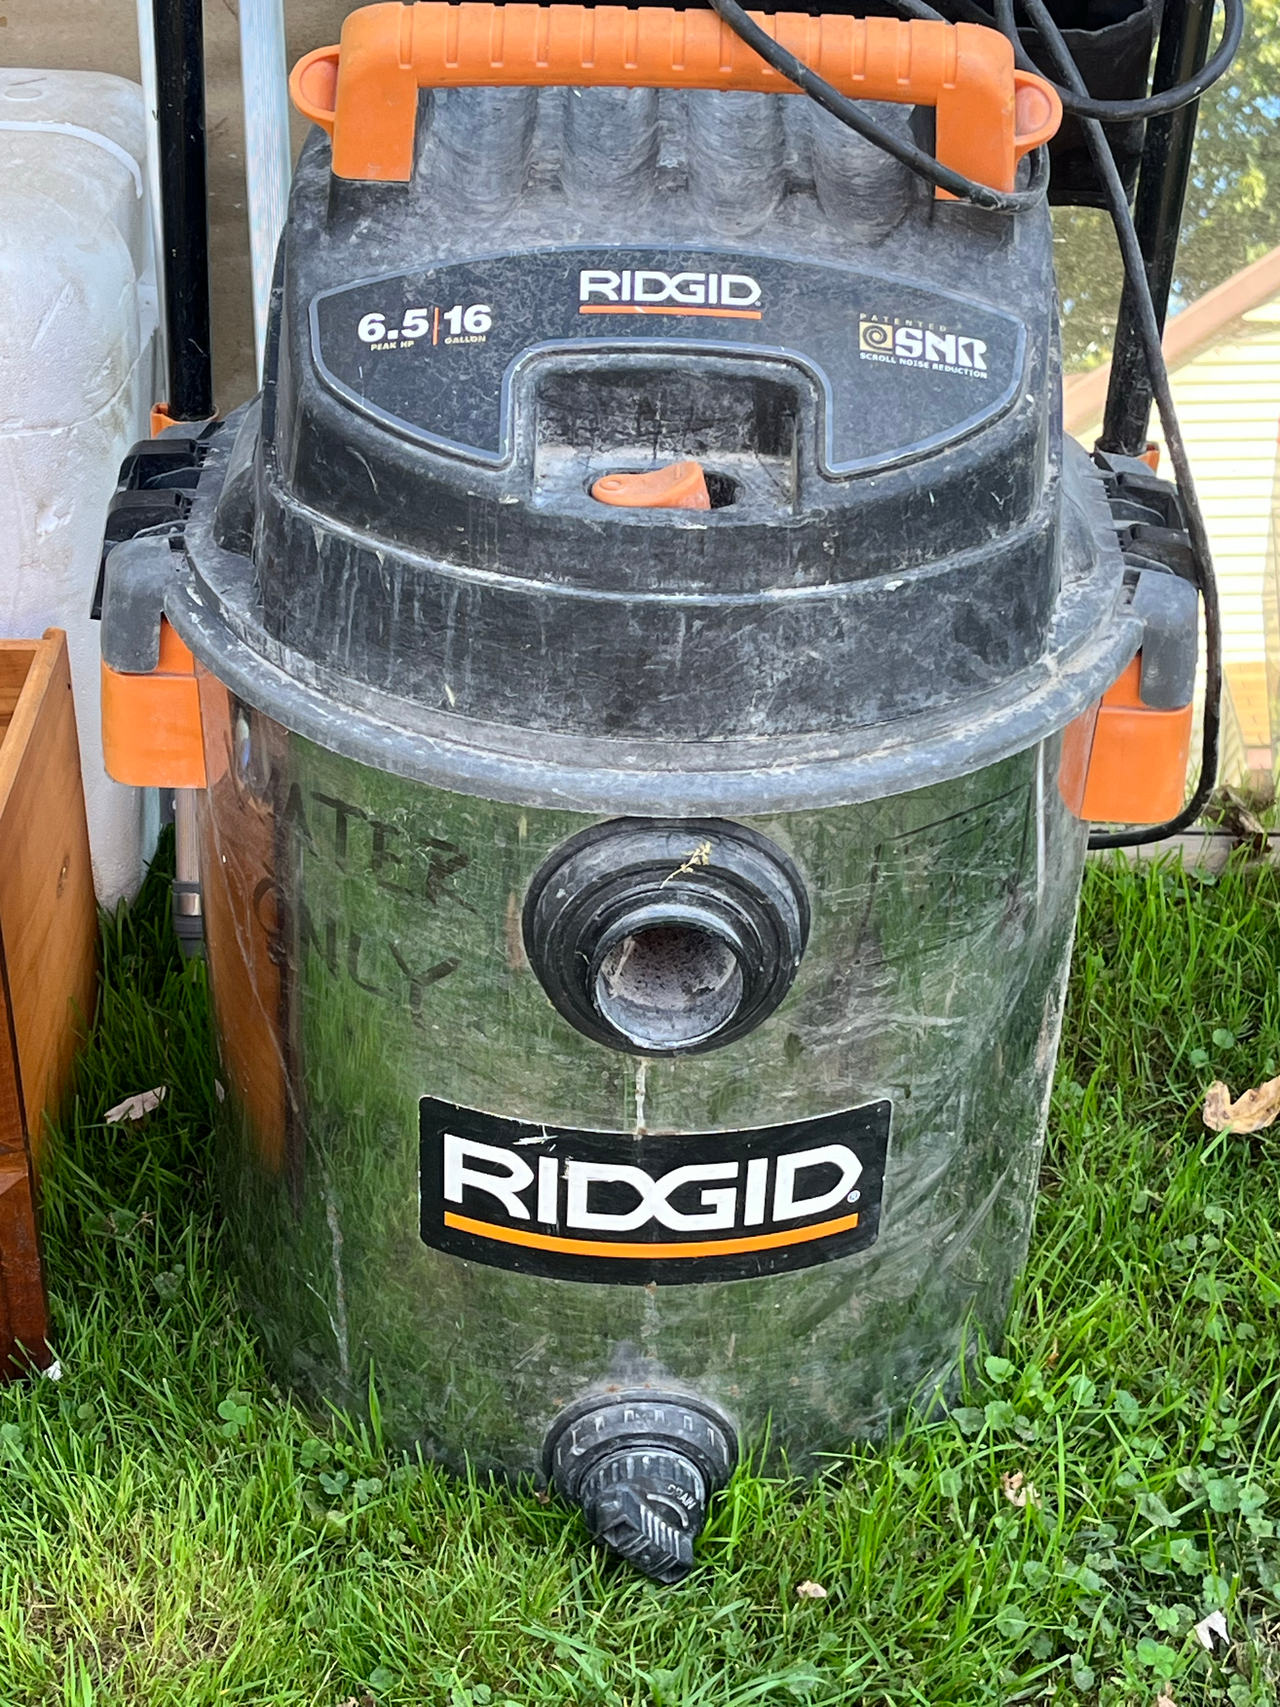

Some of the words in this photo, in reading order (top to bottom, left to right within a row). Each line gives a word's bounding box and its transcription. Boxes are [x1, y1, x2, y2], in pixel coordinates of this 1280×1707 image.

[579, 269, 764, 306] RIDGID
[357, 307, 430, 343] 6.5
[443, 303, 493, 335] 16
[859, 312, 947, 332] PATENTED
[370, 343, 397, 351] PEAK
[400, 340, 415, 349] HP
[444, 335, 487, 345] GALLON
[894, 326, 988, 370] SNR
[859, 352, 897, 365] SCROLL
[899, 357, 930, 370] NOISE
[931, 363, 988, 380] REDUCTION
[443, 1133, 863, 1232] RIDGID
